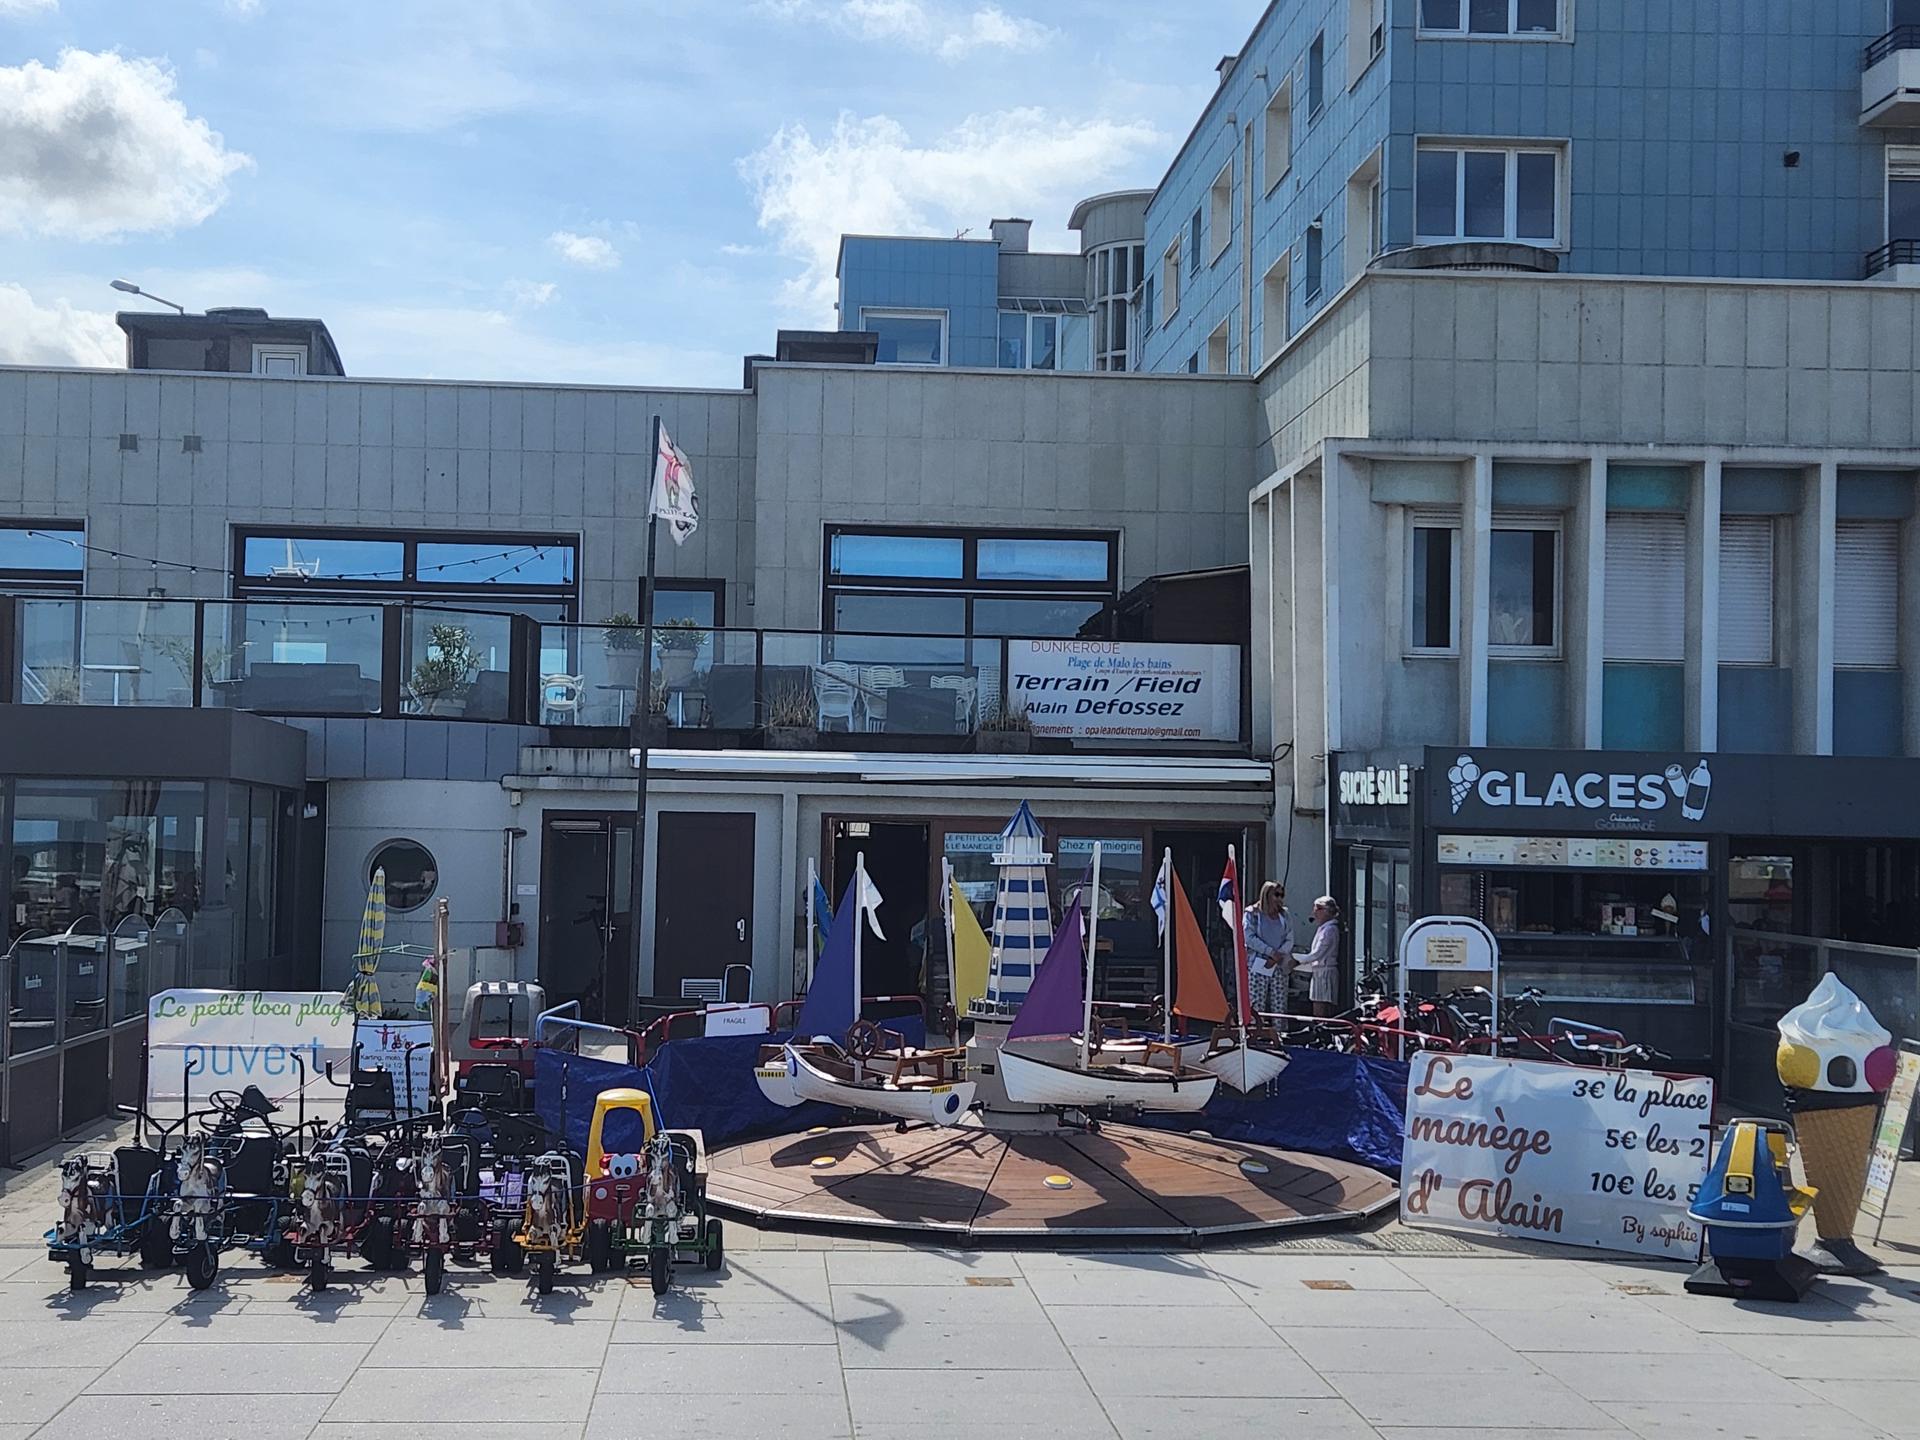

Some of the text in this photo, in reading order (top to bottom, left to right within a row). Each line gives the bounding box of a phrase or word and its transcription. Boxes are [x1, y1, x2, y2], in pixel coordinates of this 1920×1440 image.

[1031, 641, 1121, 655] DUNKERQUE
[1067, 656, 1173, 670] Plage de Malo les bains
[1014, 674, 1109, 692] Terrain
[1024, 698, 1185, 717] Alain Defossez
[1477, 770, 1668, 810] GLACES
[1058, 840, 1143, 853] Chez mmiegine
[154, 992, 350, 1027] Le petit loca plag
[722, 1017, 747, 1025] FRAGILE
[184, 1036, 325, 1077] ouvert
[1414, 1056, 1474, 1100] Le
[1572, 1073, 1709, 1118] 3€ la place
[1411, 1106, 1552, 1174] manège
[1605, 1123, 1706, 1158] 5€ les 2
[1407, 1168, 1564, 1233] d' Alain
[1591, 1171, 1635, 1195] 10€
[1643, 1167, 1678, 1201] les
[1622, 1211, 1700, 1248] By sophie
